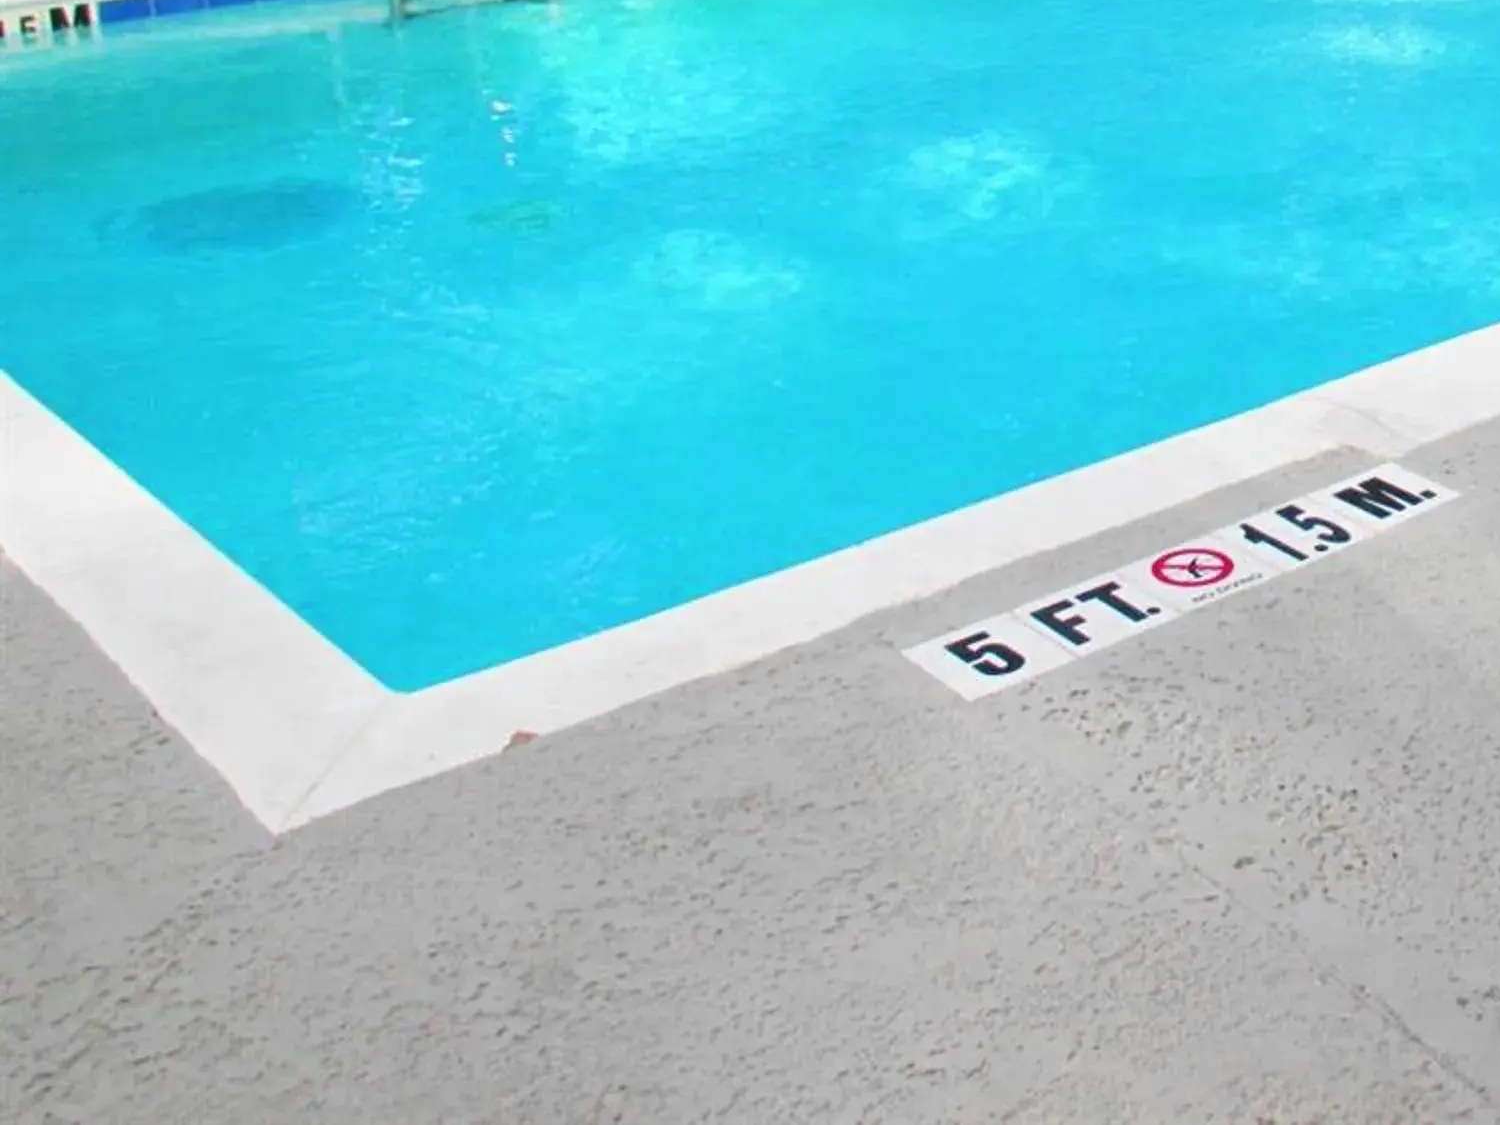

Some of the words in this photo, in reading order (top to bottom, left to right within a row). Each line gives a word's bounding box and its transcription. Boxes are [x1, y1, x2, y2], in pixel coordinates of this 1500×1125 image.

[944, 630, 1026, 676] 5
[1029, 580, 1162, 646] FT.
[1239, 504, 1352, 562] 1.5
[1333, 476, 1437, 520] M.
